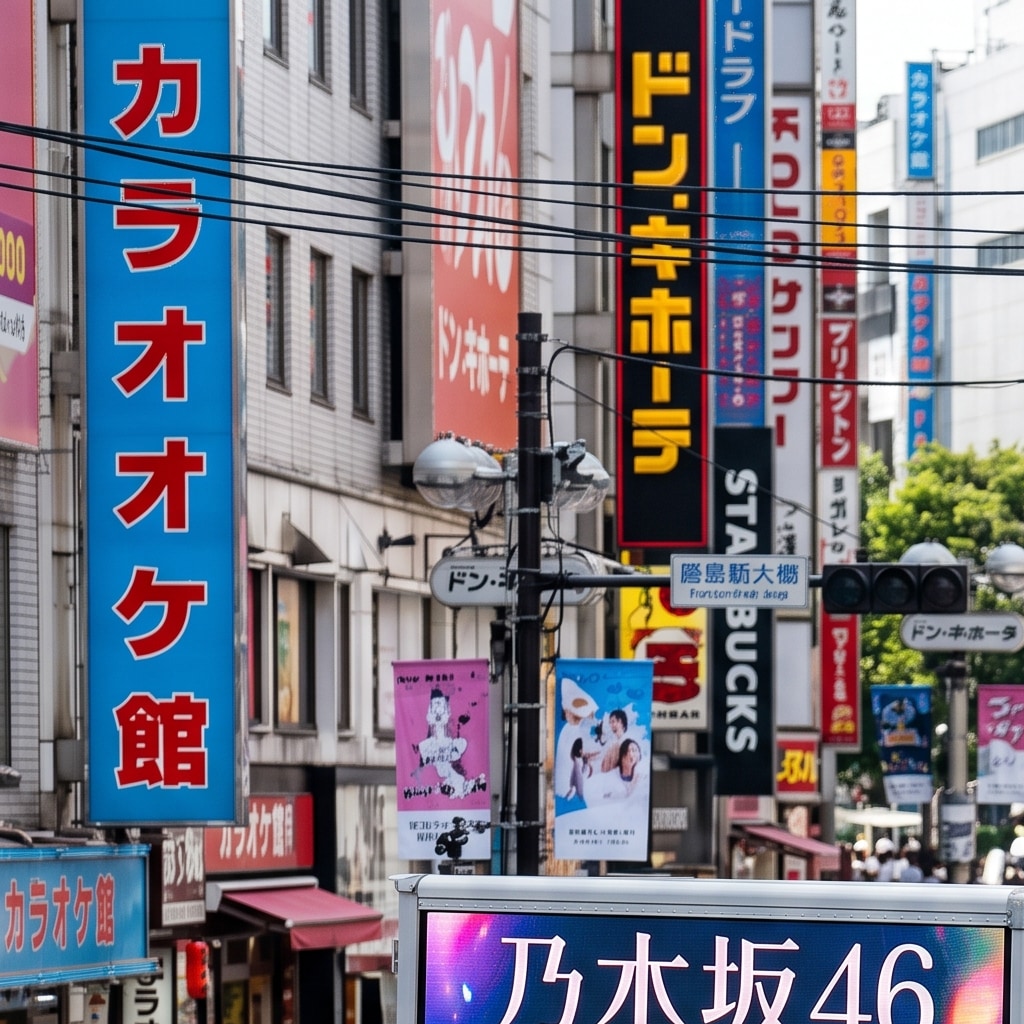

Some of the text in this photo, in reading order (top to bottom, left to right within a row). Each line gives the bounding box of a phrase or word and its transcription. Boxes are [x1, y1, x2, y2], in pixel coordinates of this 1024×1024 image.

[111, 43, 209, 789] カラオオケ館
[724, 468, 759, 754] STABUCKS
[4, 872, 116, 953] カラオケ館
